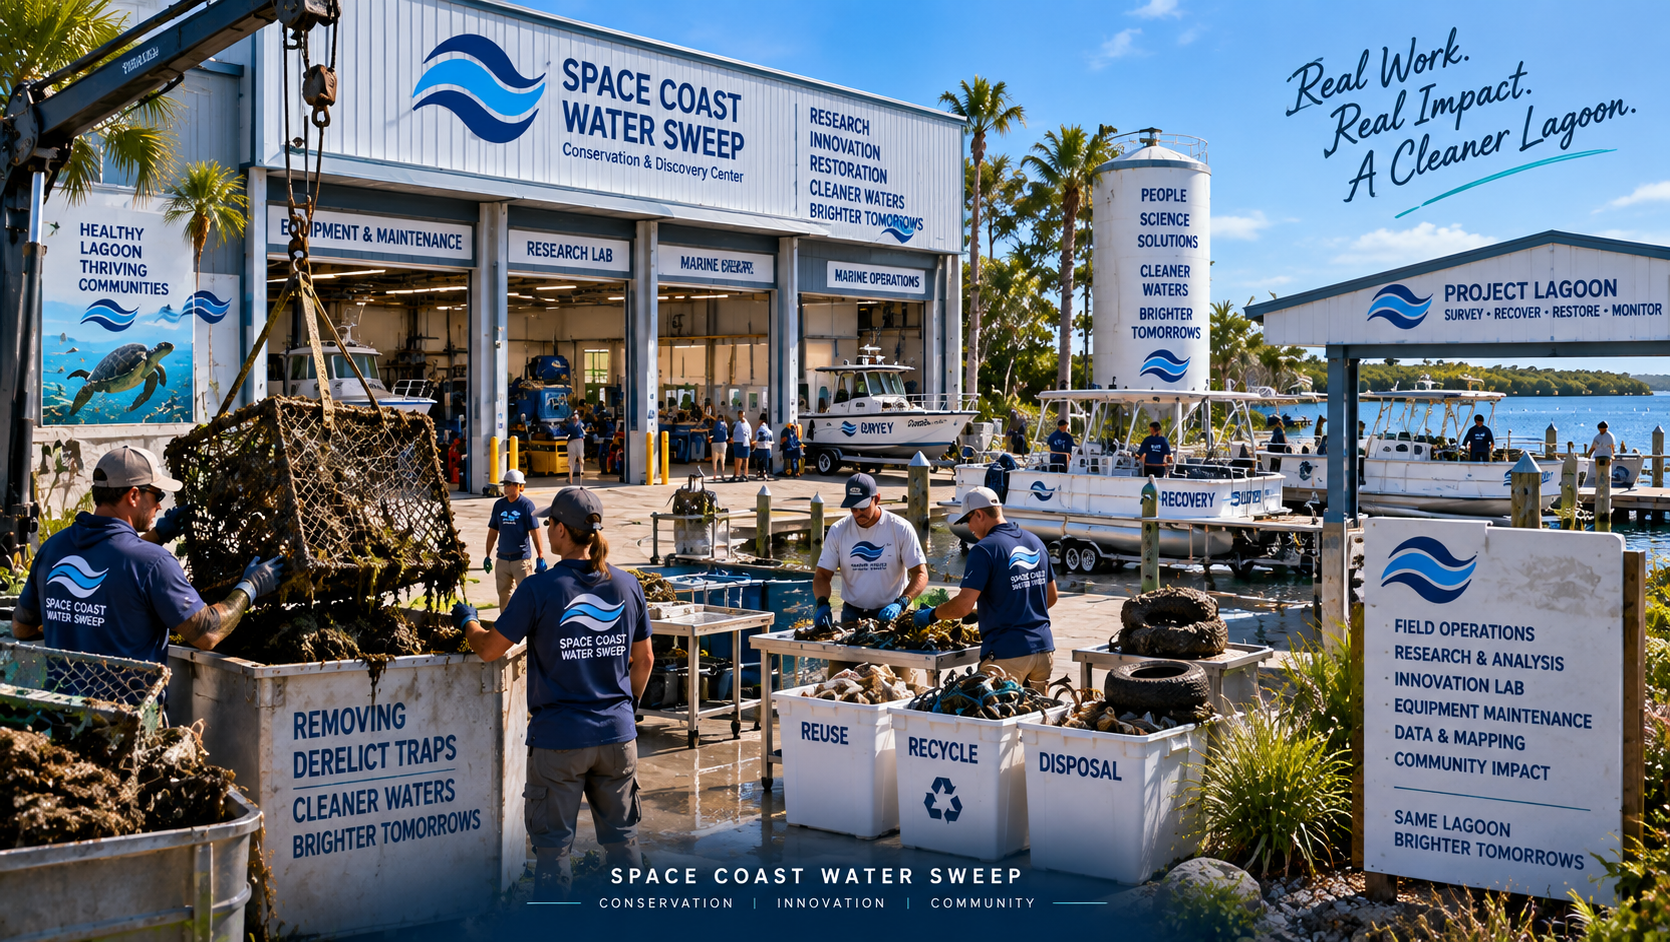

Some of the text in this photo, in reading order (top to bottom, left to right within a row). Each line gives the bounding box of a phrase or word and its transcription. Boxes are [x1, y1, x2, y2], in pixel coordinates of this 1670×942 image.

[563, 58, 741, 122] SPACE COAST
[563, 100, 744, 160] WATER SWEEP
[811, 107, 869, 136] RESEARCH
[811, 131, 880, 161] INNOVATION
[563, 142, 744, 182] Conservation & Discovery Center
[811, 155, 887, 184] RESTORATION
[810, 179, 904, 209] CLEANER WATERS
[1142, 188, 1186, 202] PEOPLE
[810, 203, 862, 224] BRIGHTER
[1140, 213, 1189, 226] SCIENCE
[81, 223, 144, 240] HEALTHY
[281, 219, 462, 250] EIPMENT & MAINTENANCE
[1138, 234, 1197, 248] SOLUTIONS
[81, 241, 141, 258] LAGOON
[528, 241, 612, 262] RESEARCH LAB
[80, 260, 147, 277] THRIVING
[681, 256, 719, 271] MARINE
[1141, 265, 1190, 277] CLEANER
[79, 278, 168, 295] COMMUNITIES
[835, 269, 919, 287] MARINE OPERATIONS
[1143, 283, 1188, 296] WATERS
[1445, 279, 1617, 302] PROJECT LAGOON
[1140, 308, 1192, 320] BRIGHTER
[1445, 308, 1483, 320] SURVEY
[1495, 307, 1540, 319] RECOVER
[1553, 305, 1600, 318] RESTORE
[1613, 303, 1662, 316] MONITOR
[1132, 326, 1200, 339] TOMORROWS
[1161, 491, 1215, 507] RECOVERY
[46, 598, 106, 615] SPACE COAST
[47, 610, 71, 622] WATER
[560, 634, 626, 649] SPACE COAST
[1395, 619, 1534, 641] FIELD OPERATIONS
[562, 649, 593, 660] WATER
[1395, 645, 1564, 671] RESEARCH & ANALYSIS
[1395, 672, 1524, 695] INNOVATION LAB
[293, 702, 406, 740] REMOVING
[1395, 698, 1592, 729] EQUIPMENT MAINTENANCE
[802, 722, 848, 745] REUSE
[1395, 725, 1525, 750] DATA & MAPPING
[294, 735, 456, 778] DERELICT TRAPS
[909, 737, 978, 764] RECYCLE
[1040, 752, 1122, 781] DISPOSAL
[1395, 752, 1550, 780] COMMUNITY IMPACT
[293, 779, 455, 823] CLEANER WATERS
[293, 809, 480, 858] BRIGHTER TOMORROWS
[1395, 810, 1510, 837] SAME LAGOON
[1395, 832, 1584, 870] BRIGHTER TOMORROWS
